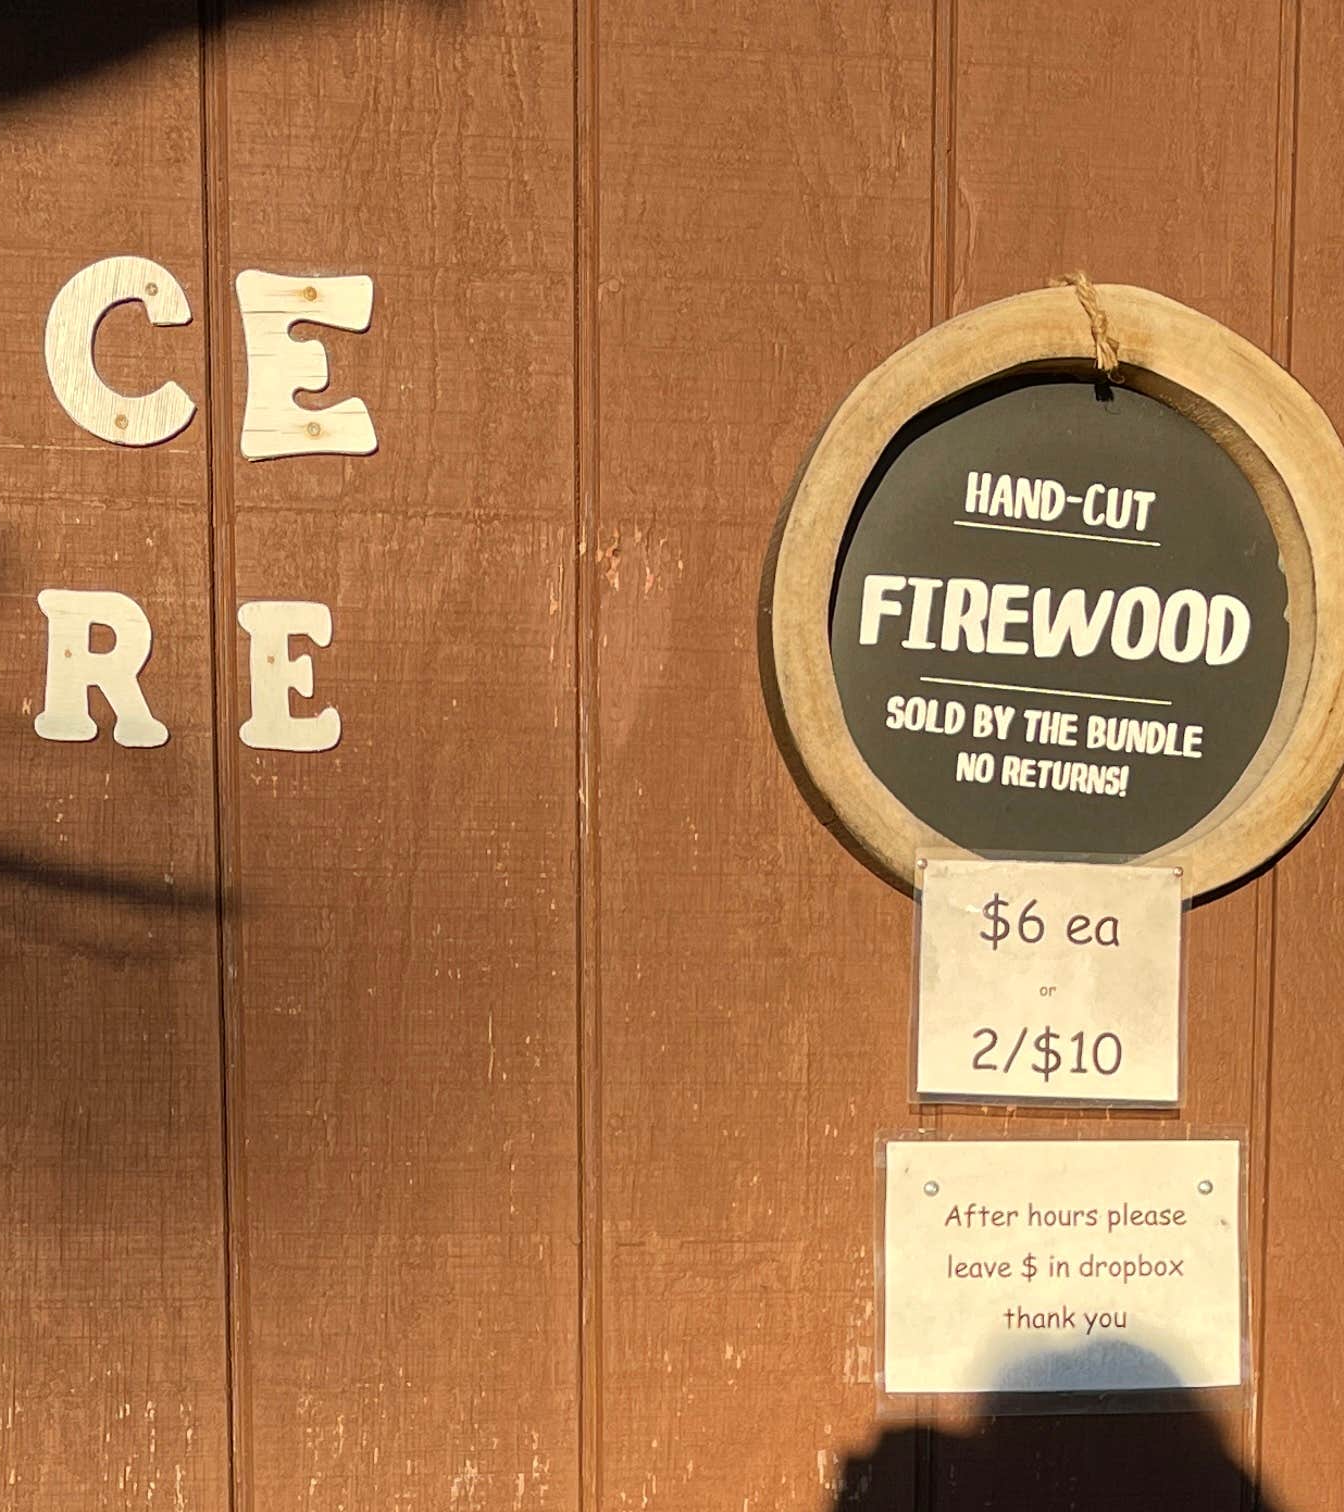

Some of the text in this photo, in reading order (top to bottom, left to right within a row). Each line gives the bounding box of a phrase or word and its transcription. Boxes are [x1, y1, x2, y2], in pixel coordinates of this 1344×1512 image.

[965, 471, 1156, 531] HAND-CUT
[859, 575, 1251, 666] FIREWOOD
[885, 695, 1205, 760] SOLD BY THE BUNDLE
[955, 751, 1131, 799] NO RETURNS!
[979, 893, 1121, 950] $6 ea
[1038, 983, 1057, 999] or
[971, 1024, 1123, 1082] 2/$10
[944, 1203, 1187, 1234] After hours please
[947, 1252, 1185, 1284] leave $ in dropbox
[1003, 1306, 1127, 1336] thank you
